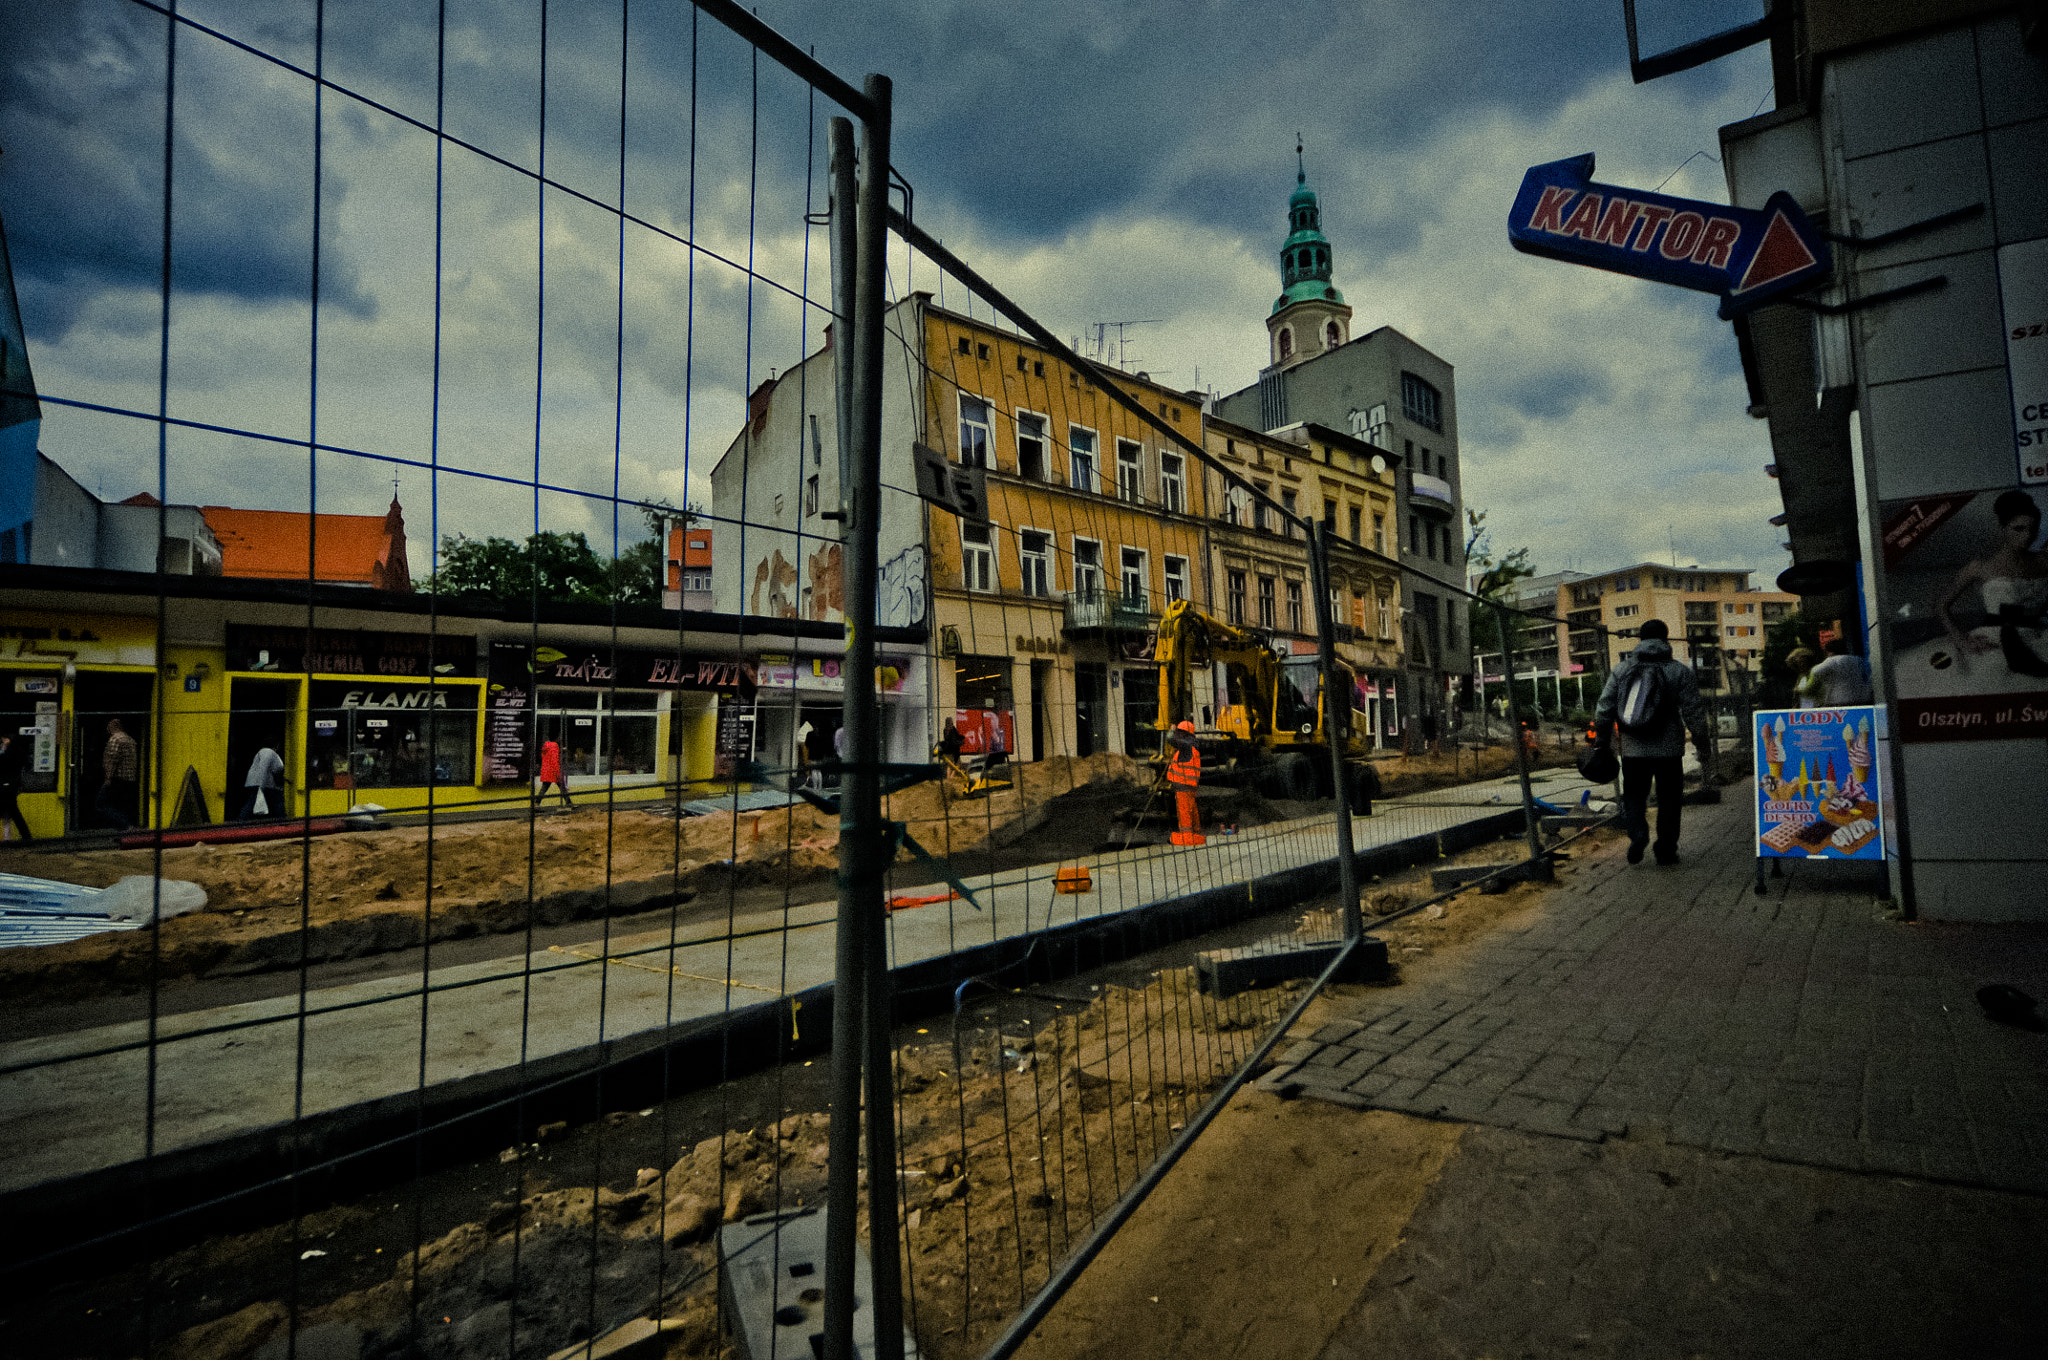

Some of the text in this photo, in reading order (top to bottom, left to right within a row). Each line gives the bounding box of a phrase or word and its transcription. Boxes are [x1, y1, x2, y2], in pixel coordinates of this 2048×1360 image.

[1528, 185, 1742, 270] KANTOR
[1788, 711, 1848, 726] LODY
[1917, 710, 1988, 729] Olsztyn,
[1763, 800, 1814, 812] GOFRY
